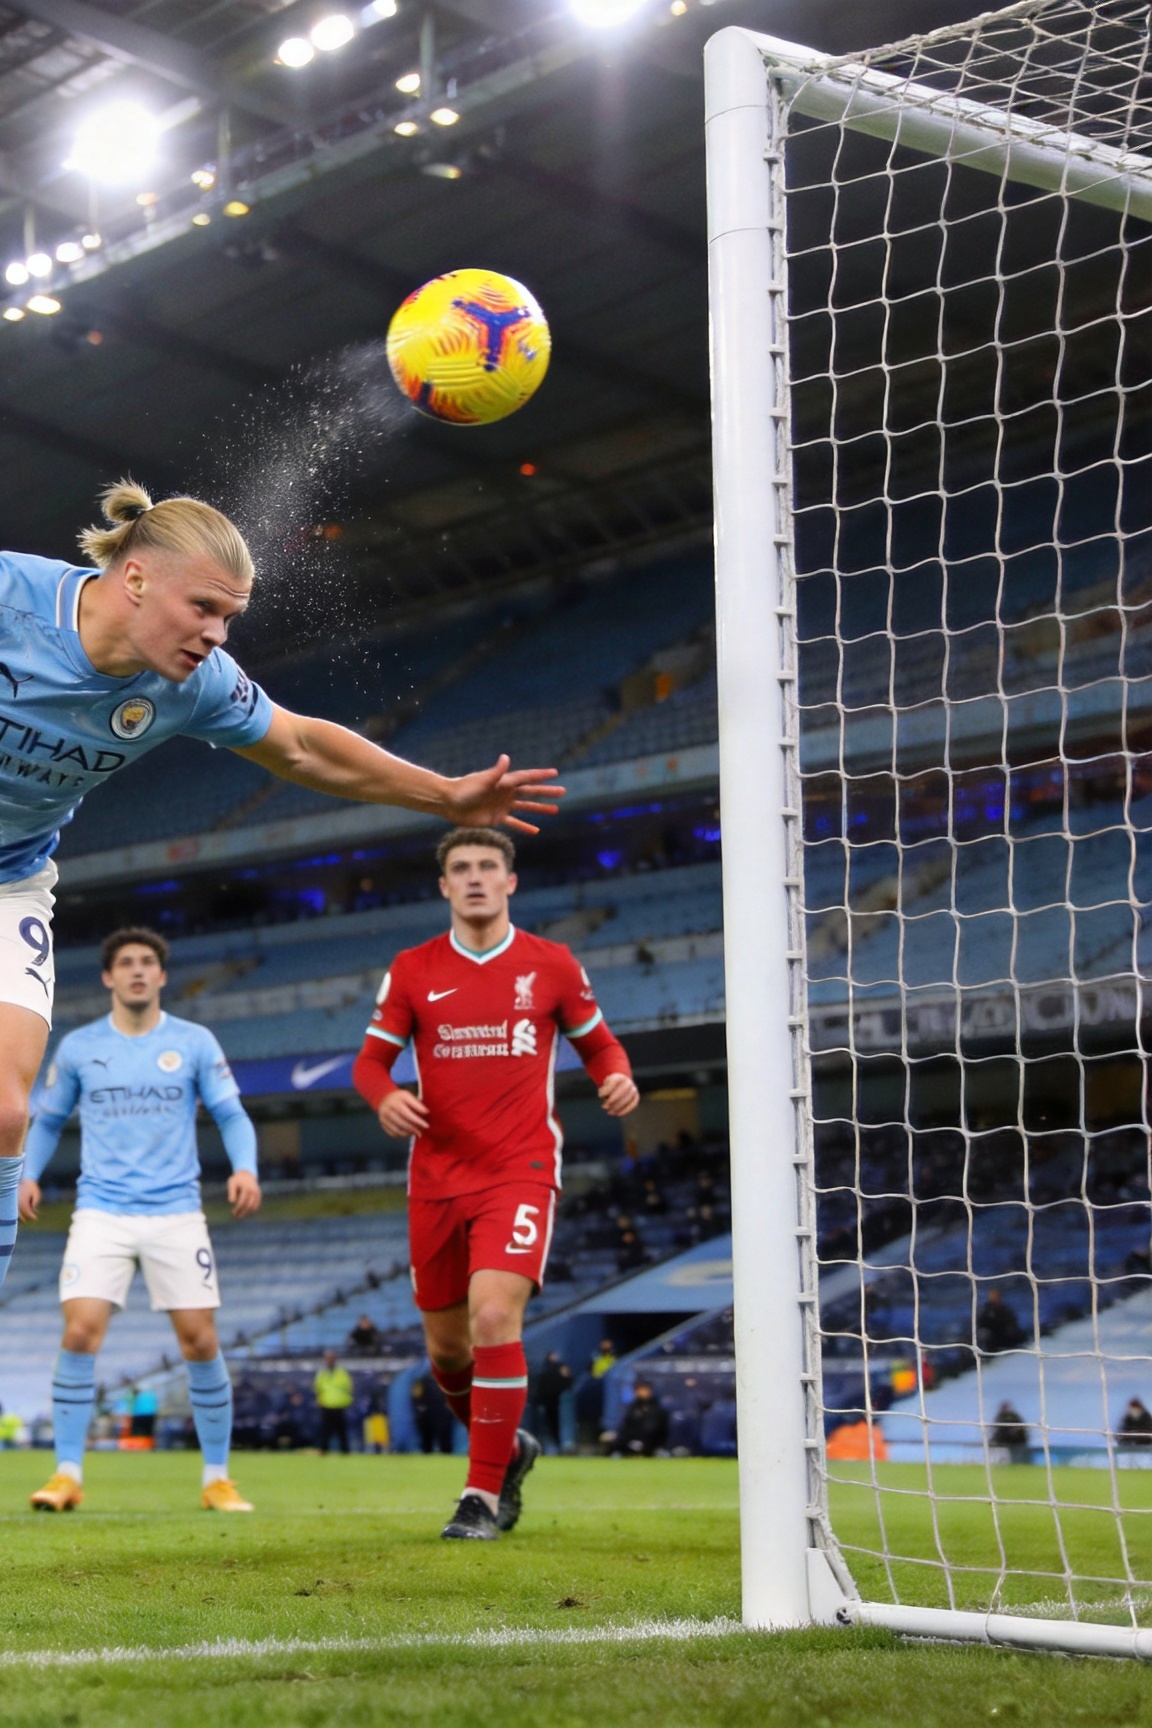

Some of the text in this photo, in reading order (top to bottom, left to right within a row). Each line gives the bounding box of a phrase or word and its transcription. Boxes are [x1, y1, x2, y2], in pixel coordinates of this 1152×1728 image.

[19, 916, 49, 966] 9
[512, 1203, 539, 1245] 5
[196, 1248, 212, 1280] 9
